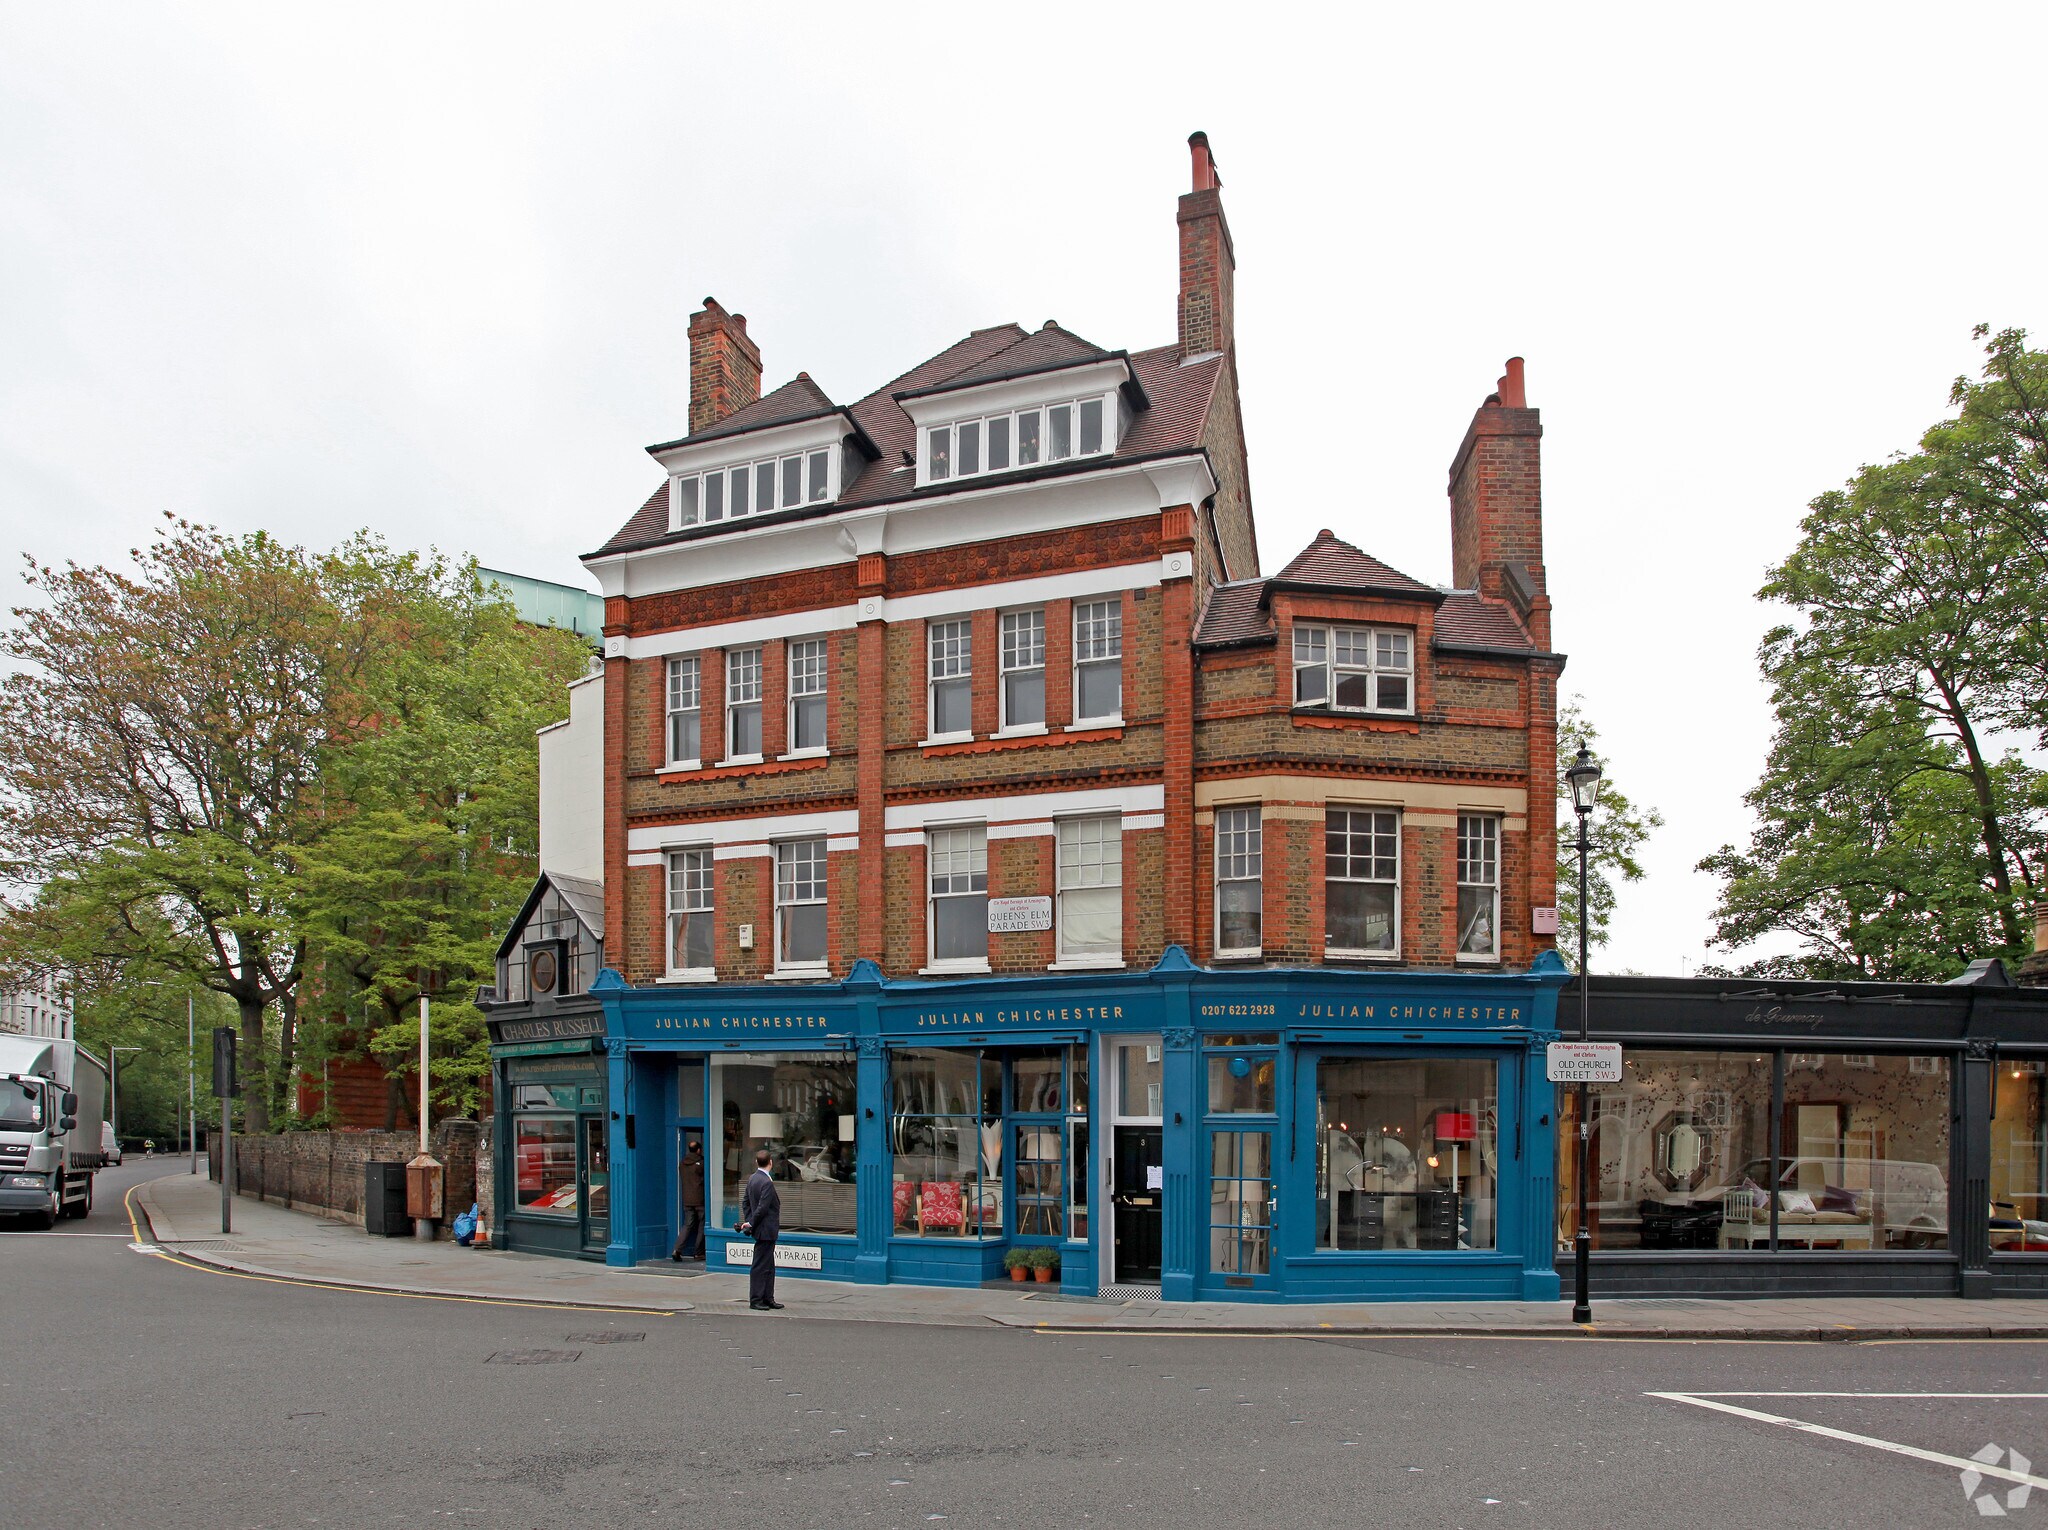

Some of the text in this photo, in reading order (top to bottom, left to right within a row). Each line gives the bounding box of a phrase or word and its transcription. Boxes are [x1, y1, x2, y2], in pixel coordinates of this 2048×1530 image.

[990, 910, 1050, 921] QUEENS ELM
[990, 921, 1029, 930] PARADE
[918, 1006, 1124, 1026] JULIAN CHICHESTER
[1201, 1004, 1276, 1016] 0207 622 2928
[1299, 1004, 1521, 1020] JULIAN CHICHESTER
[1745, 1006, 1761, 1022] de
[655, 1016, 828, 1029] JULIAN CHICHESTER
[502, 1017, 605, 1041] CHARLES RUSSELL
[1558, 1060, 1611, 1069] OLD CHURCH
[1595, 1071, 1616, 1079] SW3
[1140, 1138, 1146, 1146] 3
[784, 1250, 819, 1262] PARADE
